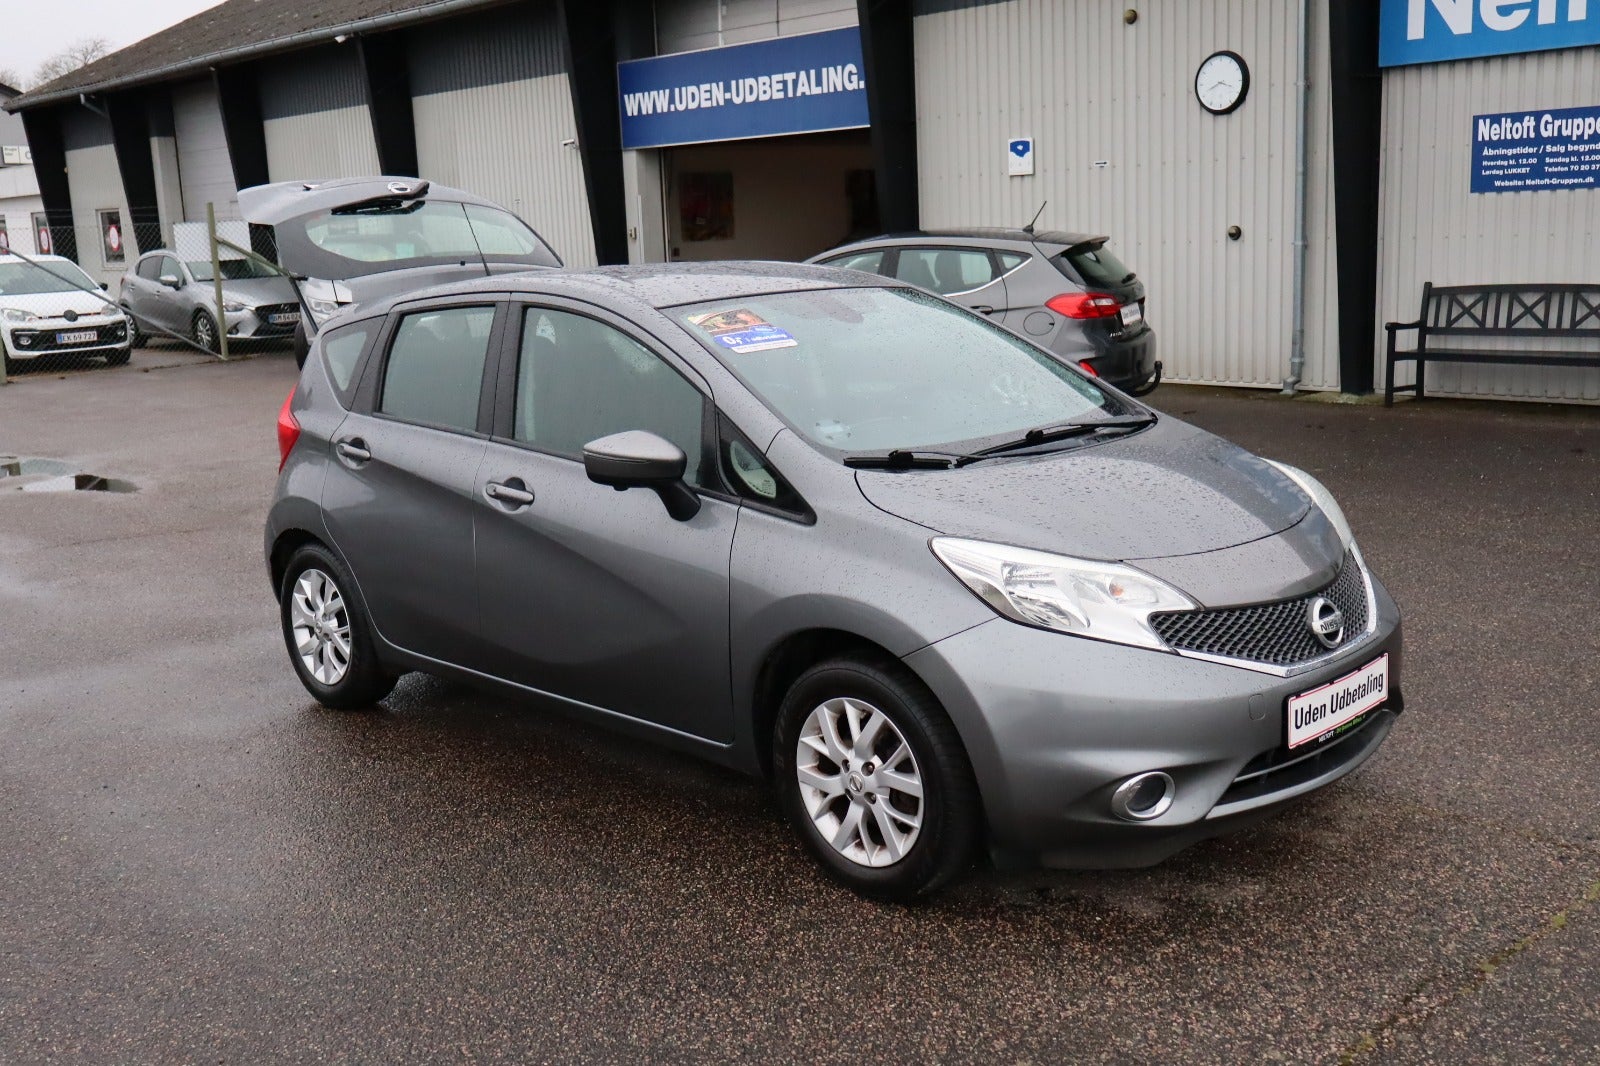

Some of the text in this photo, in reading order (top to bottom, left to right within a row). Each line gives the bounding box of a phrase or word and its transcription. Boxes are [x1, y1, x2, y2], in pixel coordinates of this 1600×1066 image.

[623, 63, 865, 117] WWW.UDEN-UDBETALING.
[1478, 116, 1536, 142] Neltoft
[1483, 147, 1538, 156] Åbningstider
[1294, 703, 1327, 730] Uden
[1330, 672, 1384, 714] Udbetaling
